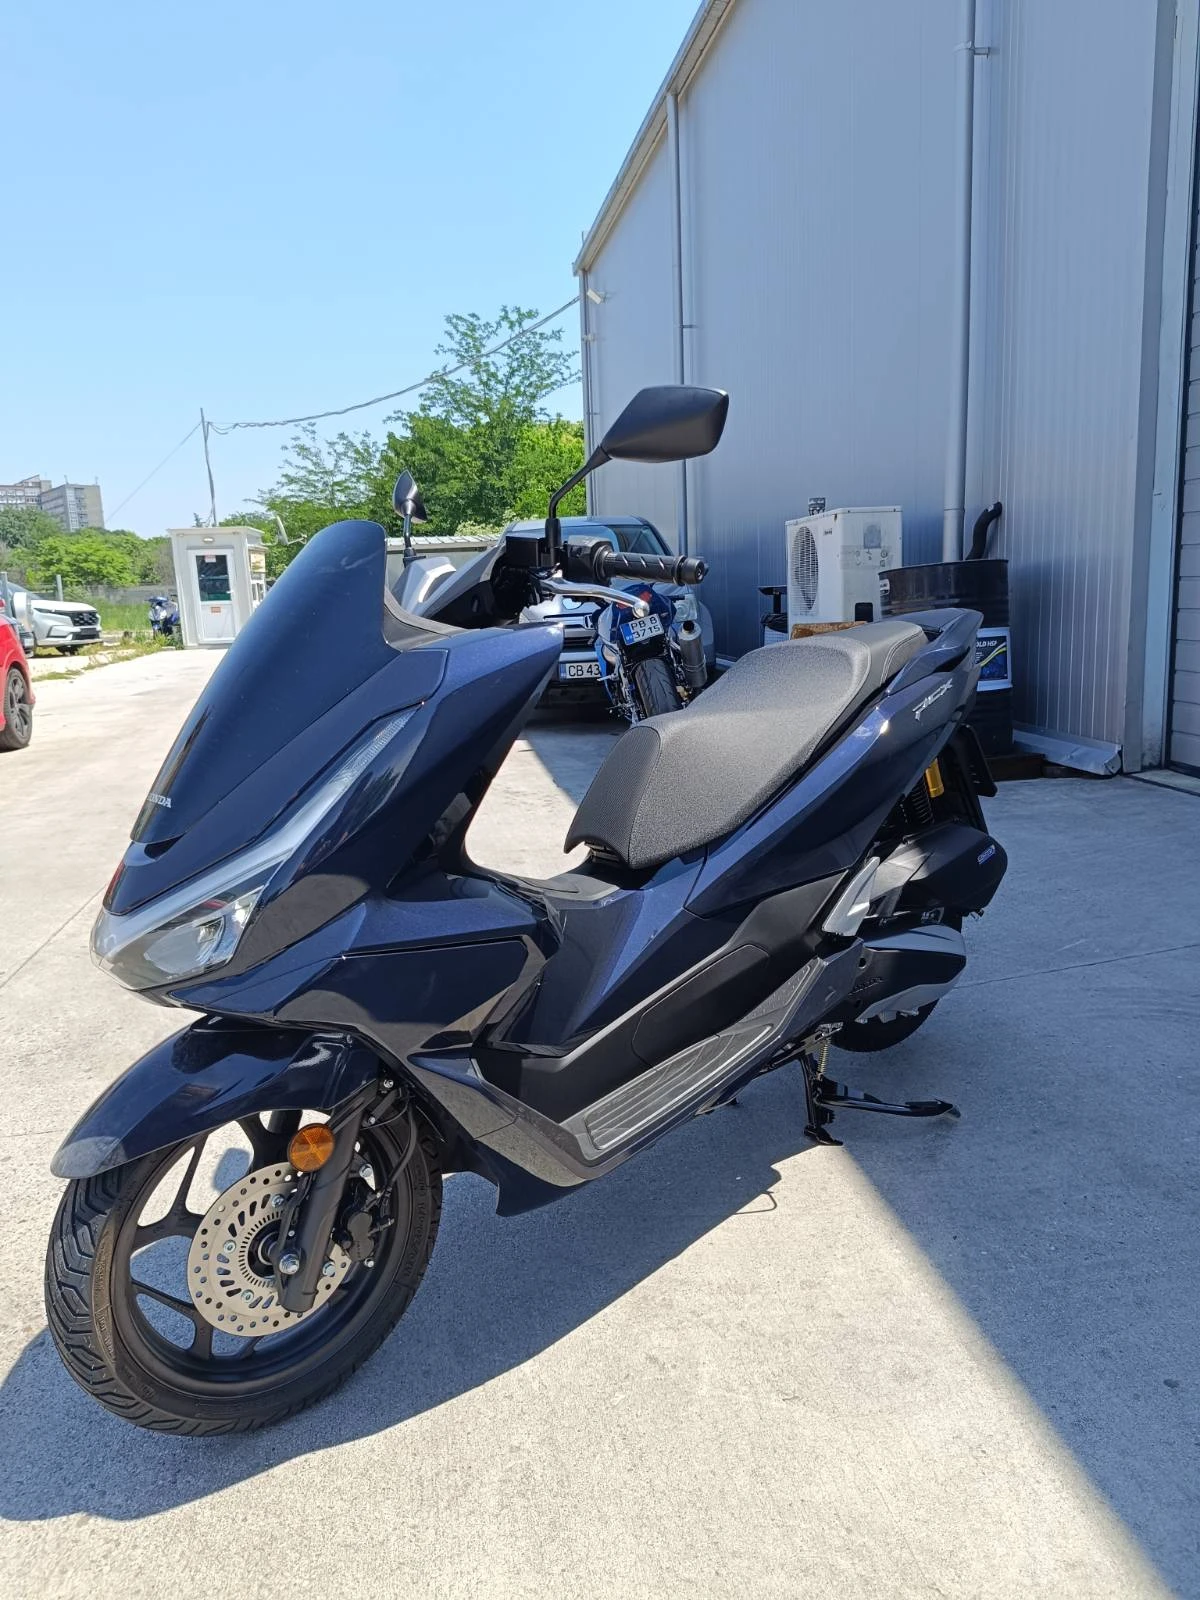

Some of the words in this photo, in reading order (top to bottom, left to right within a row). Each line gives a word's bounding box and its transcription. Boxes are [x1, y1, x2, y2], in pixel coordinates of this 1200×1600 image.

[650, 616, 658, 625] 8
[632, 624, 661, 639] 3715
[568, 664, 584, 677] CB
